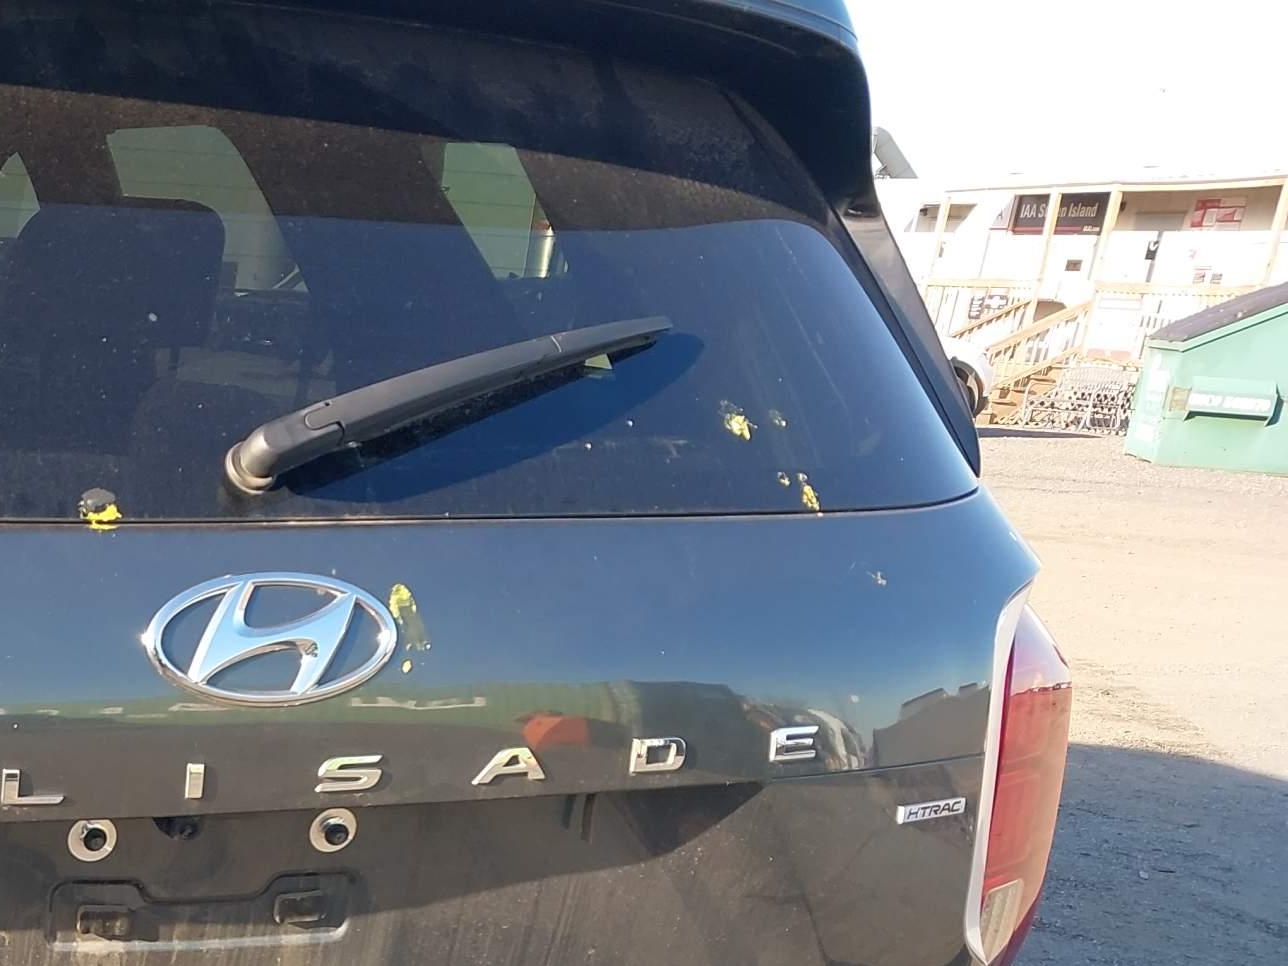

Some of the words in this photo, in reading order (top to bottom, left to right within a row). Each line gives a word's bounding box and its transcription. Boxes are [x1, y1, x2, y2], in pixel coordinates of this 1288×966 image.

[1019, 203, 1038, 219] IAA
[1068, 201, 1099, 219] Island
[905, 799, 963, 821] HTRAC
